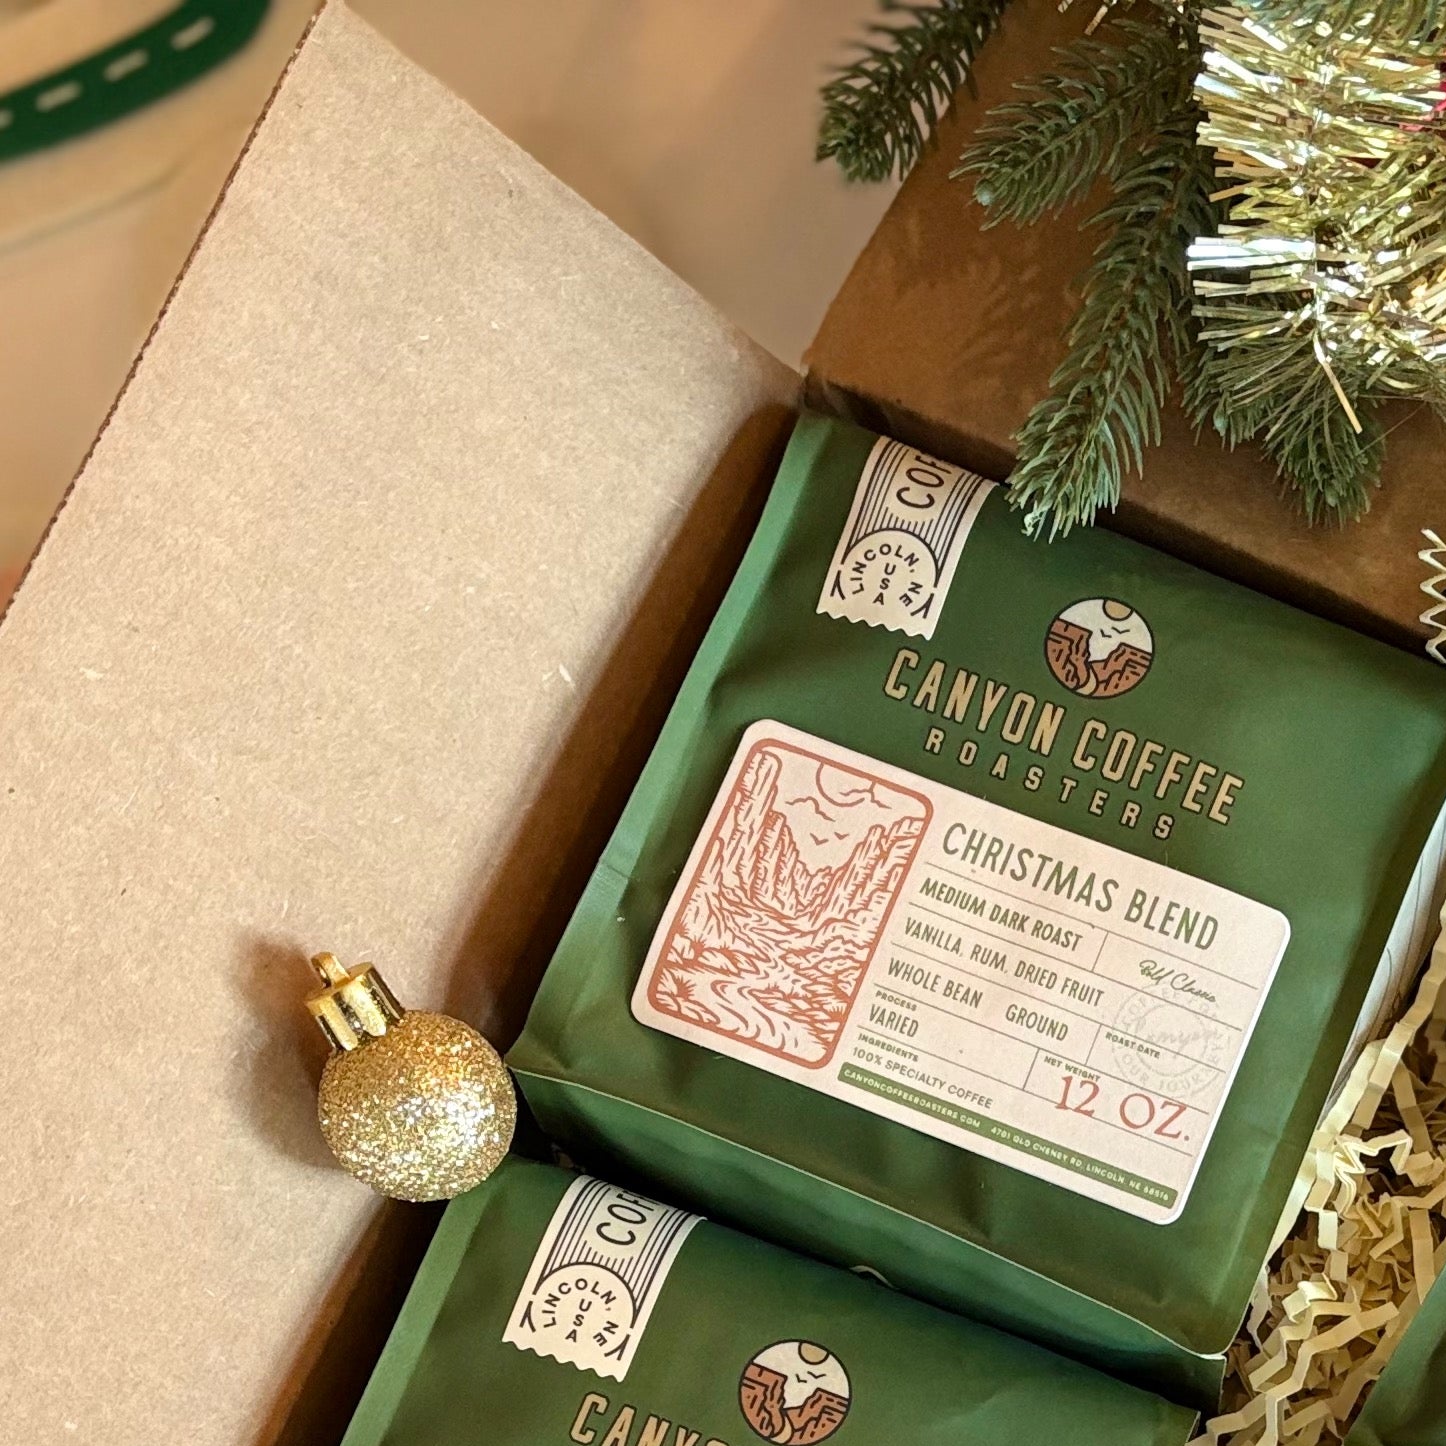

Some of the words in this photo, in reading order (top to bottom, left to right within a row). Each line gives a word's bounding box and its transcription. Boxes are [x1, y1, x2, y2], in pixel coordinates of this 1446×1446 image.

[850, 543, 920, 595] LINCOLN,
[899, 581, 923, 607] NE
[882, 647, 1067, 758] CANYON
[1070, 717, 1245, 826] COFFEE
[923, 725, 1175, 841] ROASTERS
[919, 877, 987, 918] MEDIUM
[988, 903, 1031, 933] DARK
[1030, 919, 1083, 952] ROAST
[942, 822, 1120, 913] CHRISTMAS
[1123, 888, 1219, 951] BLEND
[888, 957, 942, 993] WHOLE
[942, 979, 984, 1009] BEAN
[904, 916, 967, 957] VANILLA,
[969, 943, 1008, 974] RUM,
[1013, 959, 1058, 990] DRIED
[1060, 977, 1105, 1007] FRUIT
[869, 1003, 919, 1038] VARIED
[875, 990, 917, 1012] PROCESS
[1005, 1003, 1069, 1042] GROUND
[857, 1033, 919, 1062] INGREDIENTS
[1043, 1055, 1063, 1068] NET
[1064, 1063, 1101, 1082] WEIGHT
[1105, 1031, 1137, 1049] ROAST
[1136, 1043, 1161, 1059] DATE
[852, 1046, 883, 1066] 100%
[884, 1059, 947, 1090] SPECIALTY
[947, 1084, 993, 1109] COFFEE
[1057, 1075, 1101, 1118] 12
[1119, 1093, 1187, 1140] OZ.
[1012, 1135, 1031, 1148] OLD
[1129, 1180, 1141, 1191] NE
[541, 1278, 617, 1328] LINCOLN,
[593, 1321, 619, 1347] NE
